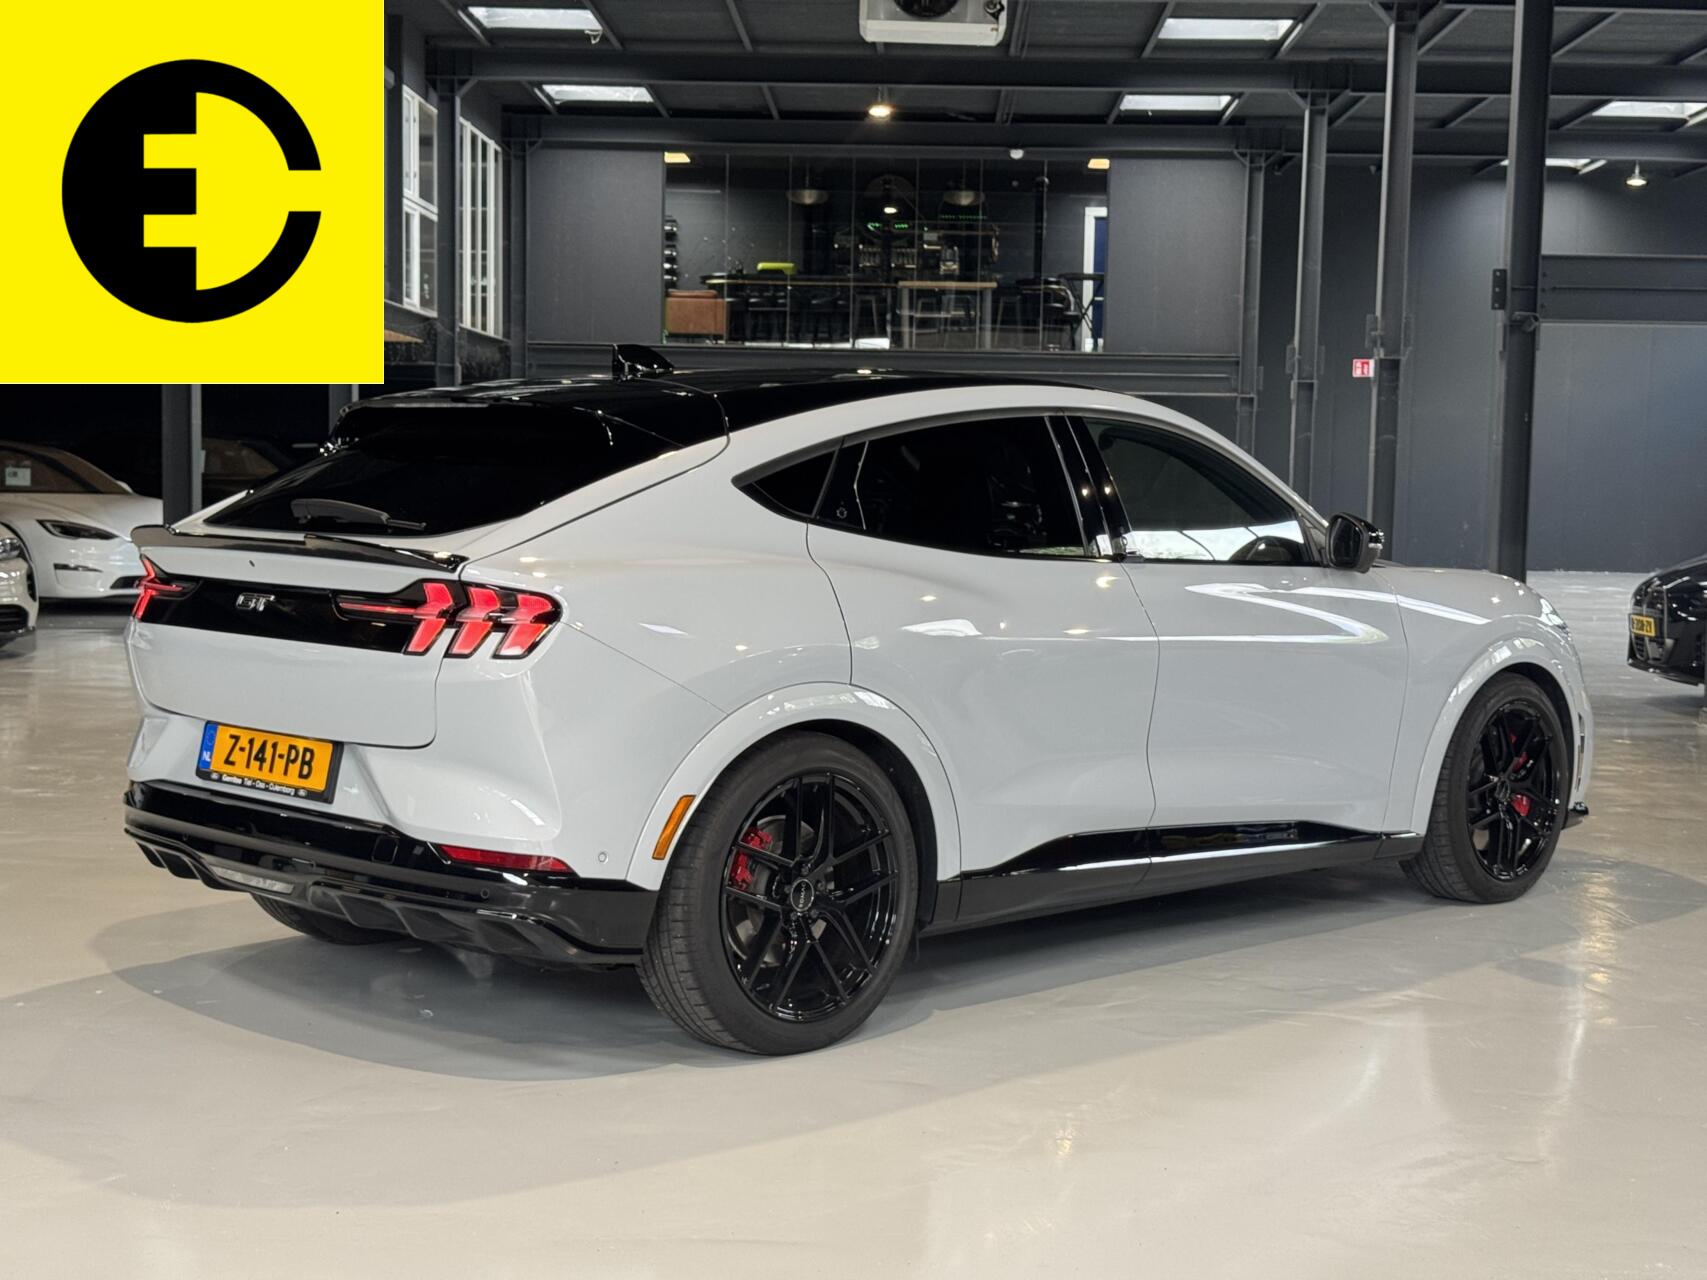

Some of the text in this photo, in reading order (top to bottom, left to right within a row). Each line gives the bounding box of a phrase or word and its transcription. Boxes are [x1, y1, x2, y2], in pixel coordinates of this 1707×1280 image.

[236, 592, 275, 611] GT
[202, 751, 212, 762] NL
[223, 734, 315, 780] Z-141-PB
